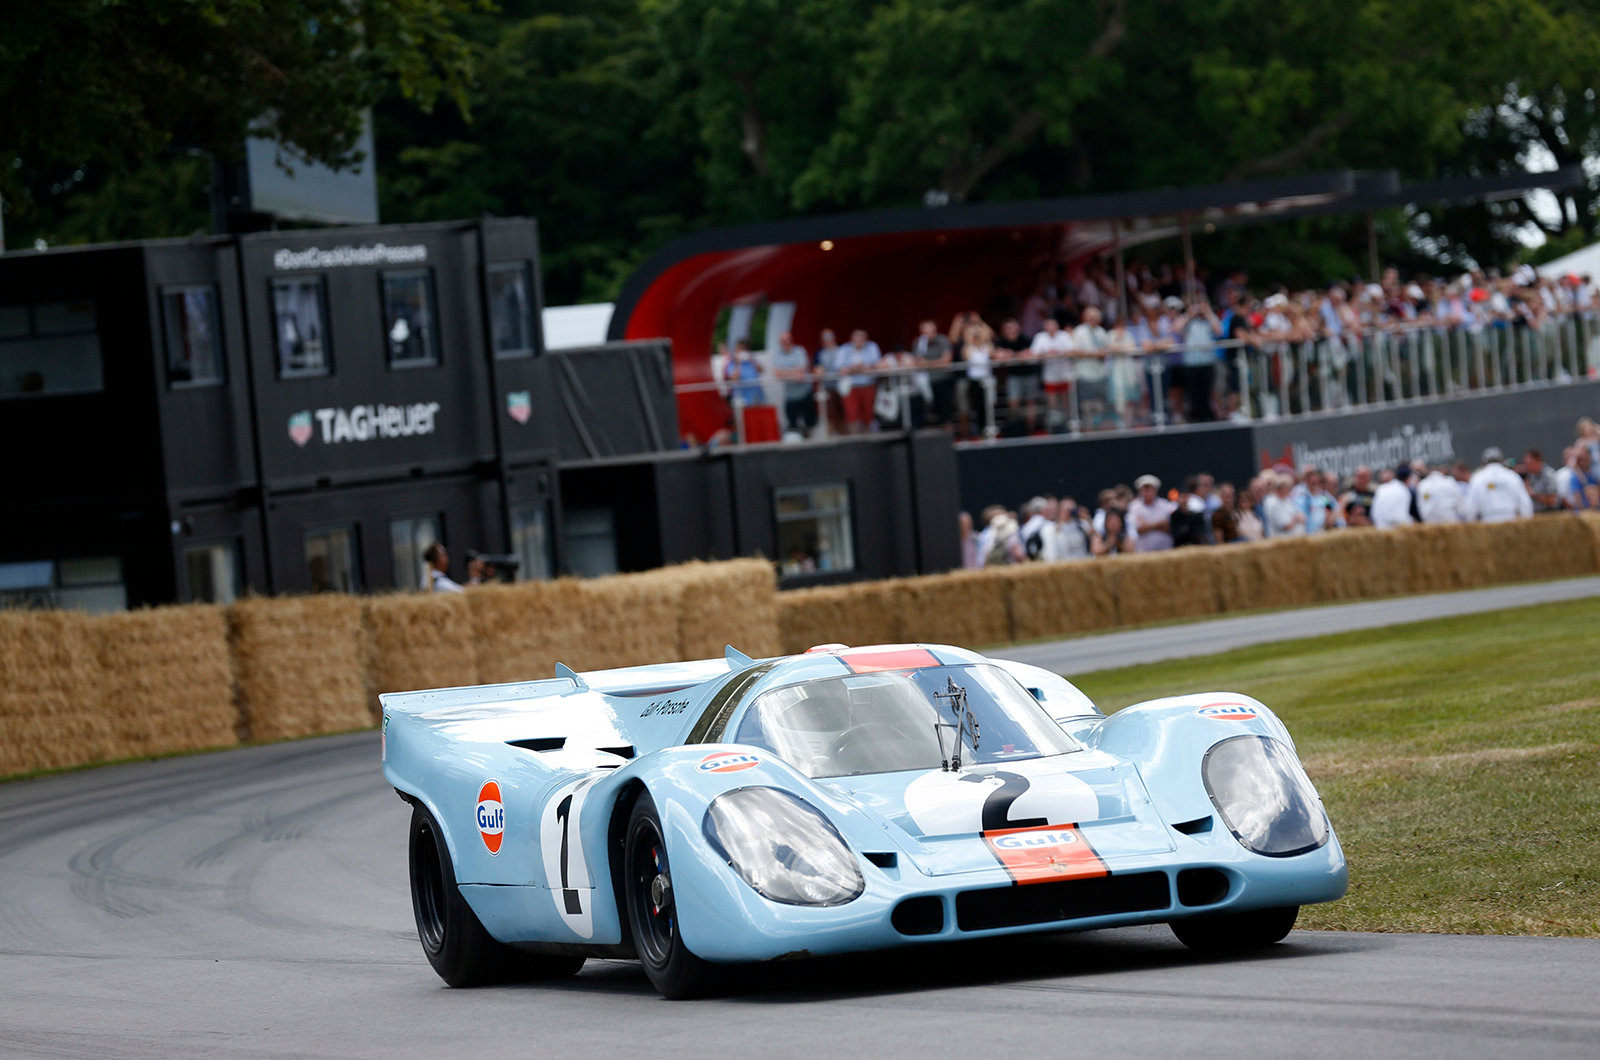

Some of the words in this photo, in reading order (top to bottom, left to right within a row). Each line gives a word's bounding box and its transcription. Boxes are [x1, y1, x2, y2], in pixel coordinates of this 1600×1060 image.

[699, 754, 760, 771] Gulf
[958, 770, 1049, 831] 2
[477, 805, 504, 829] Gulf
[996, 832, 1073, 848] Gulf
